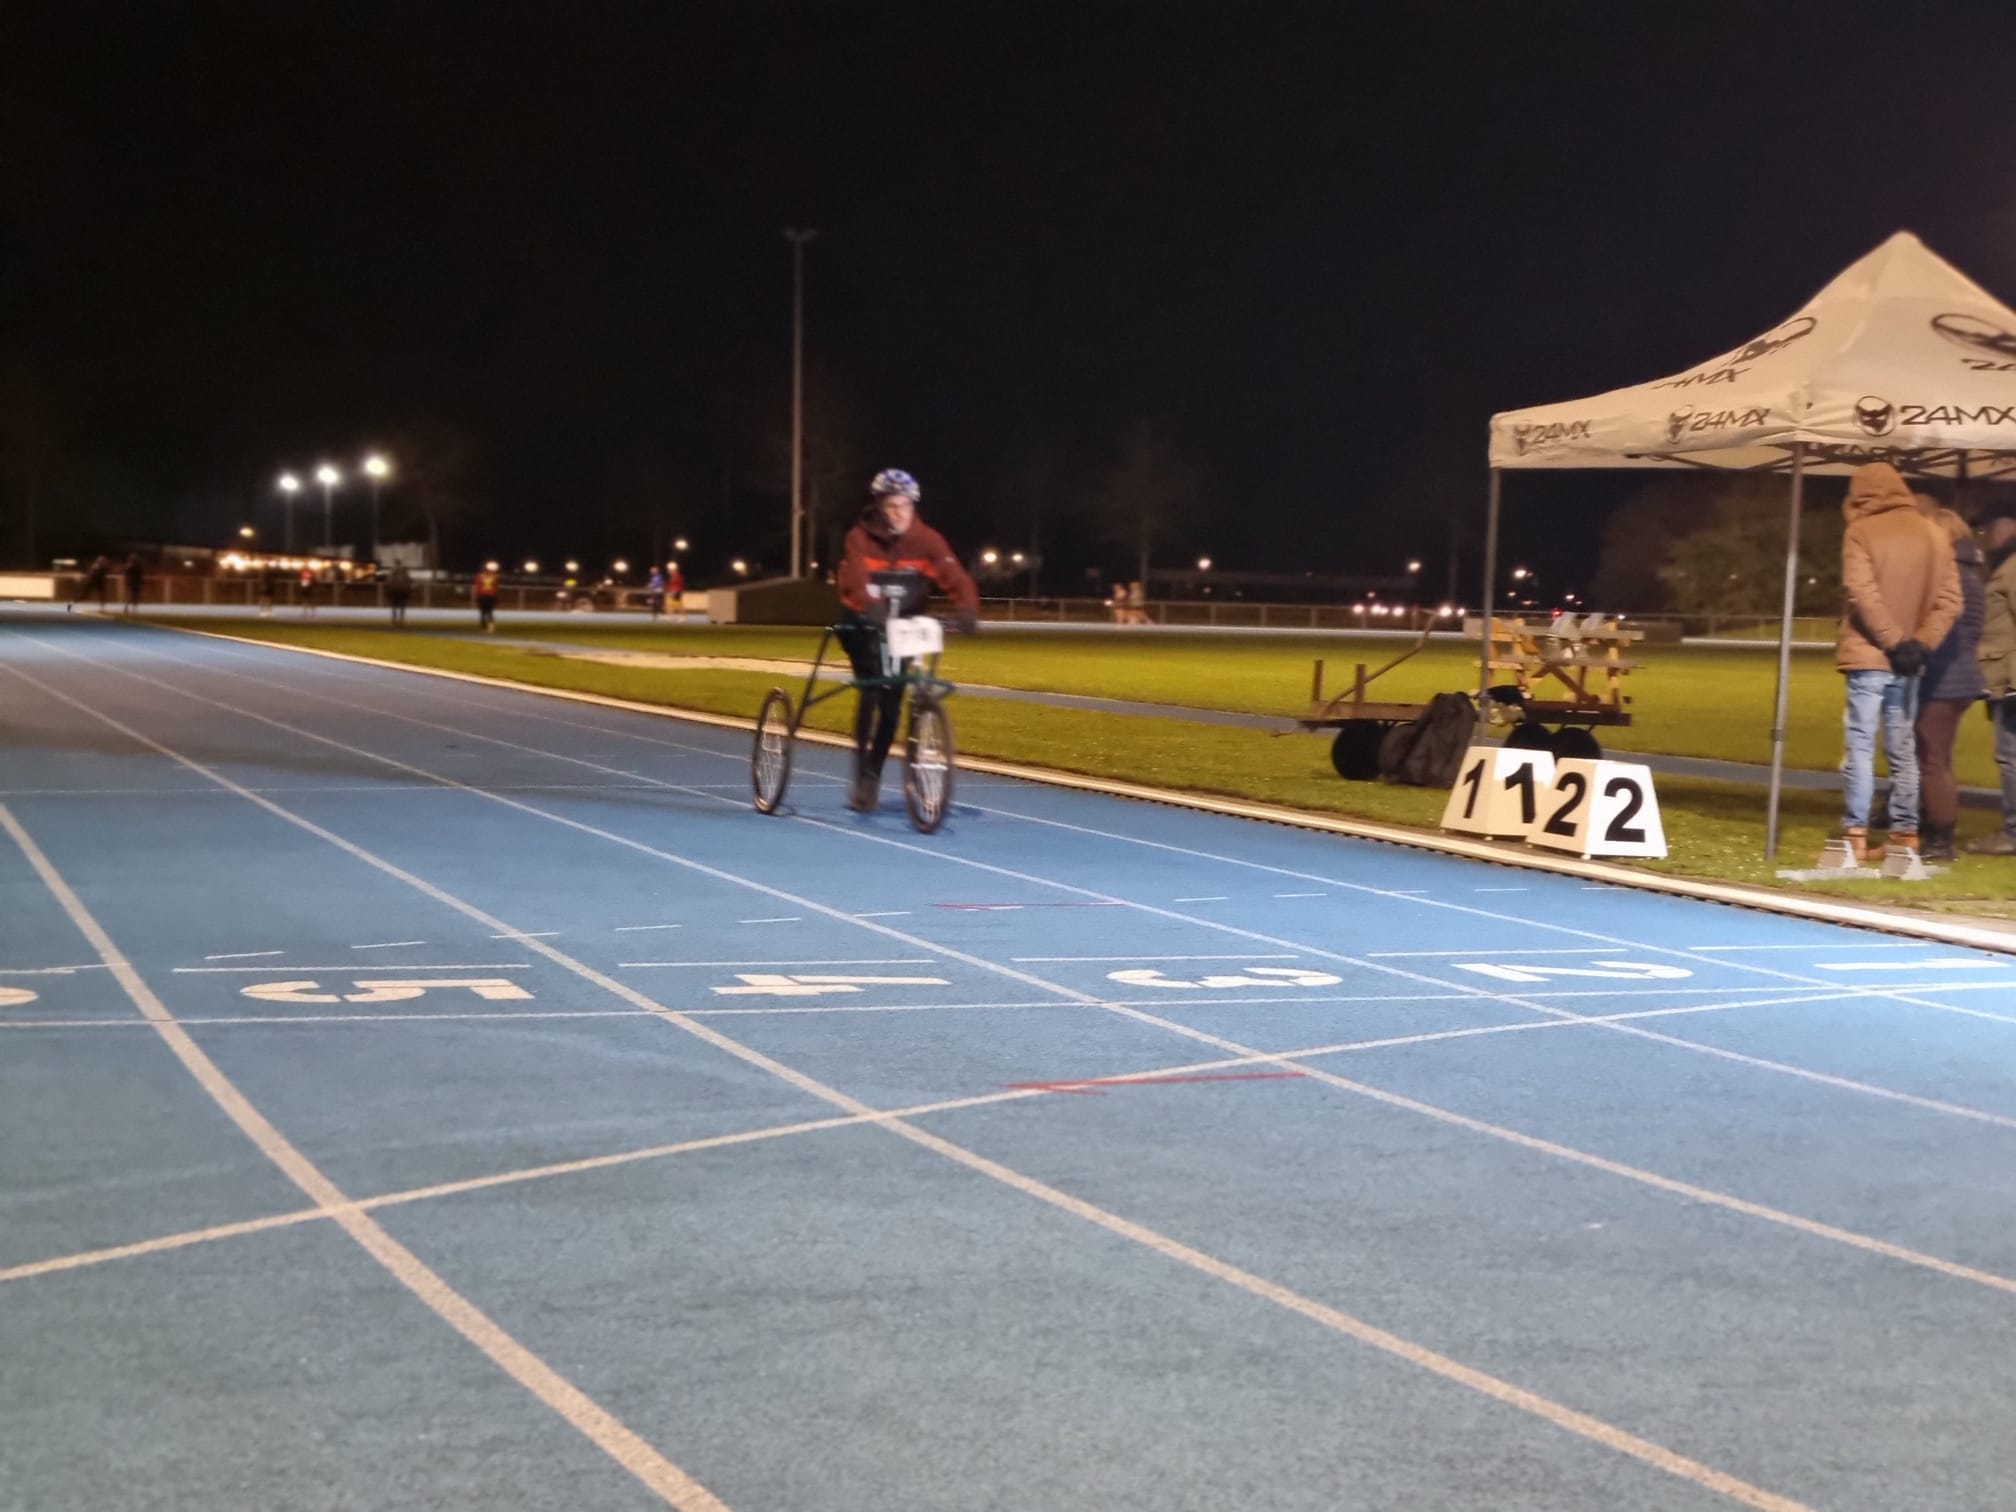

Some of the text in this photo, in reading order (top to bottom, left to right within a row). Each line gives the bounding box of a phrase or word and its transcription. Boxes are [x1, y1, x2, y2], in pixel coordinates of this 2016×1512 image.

[1689, 408, 1771, 431] 24MX
[1901, 405, 2016, 425] 24MX
[1533, 420, 1592, 444] 24MX
[1463, 758, 1486, 819] 1
[1505, 762, 1536, 824] 1
[1543, 772, 1586, 837] 2
[1604, 777, 1646, 843] 2
[1106, 967, 1343, 988] 3
[1451, 961, 1694, 982] 2
[240, 979, 535, 1002] 5
